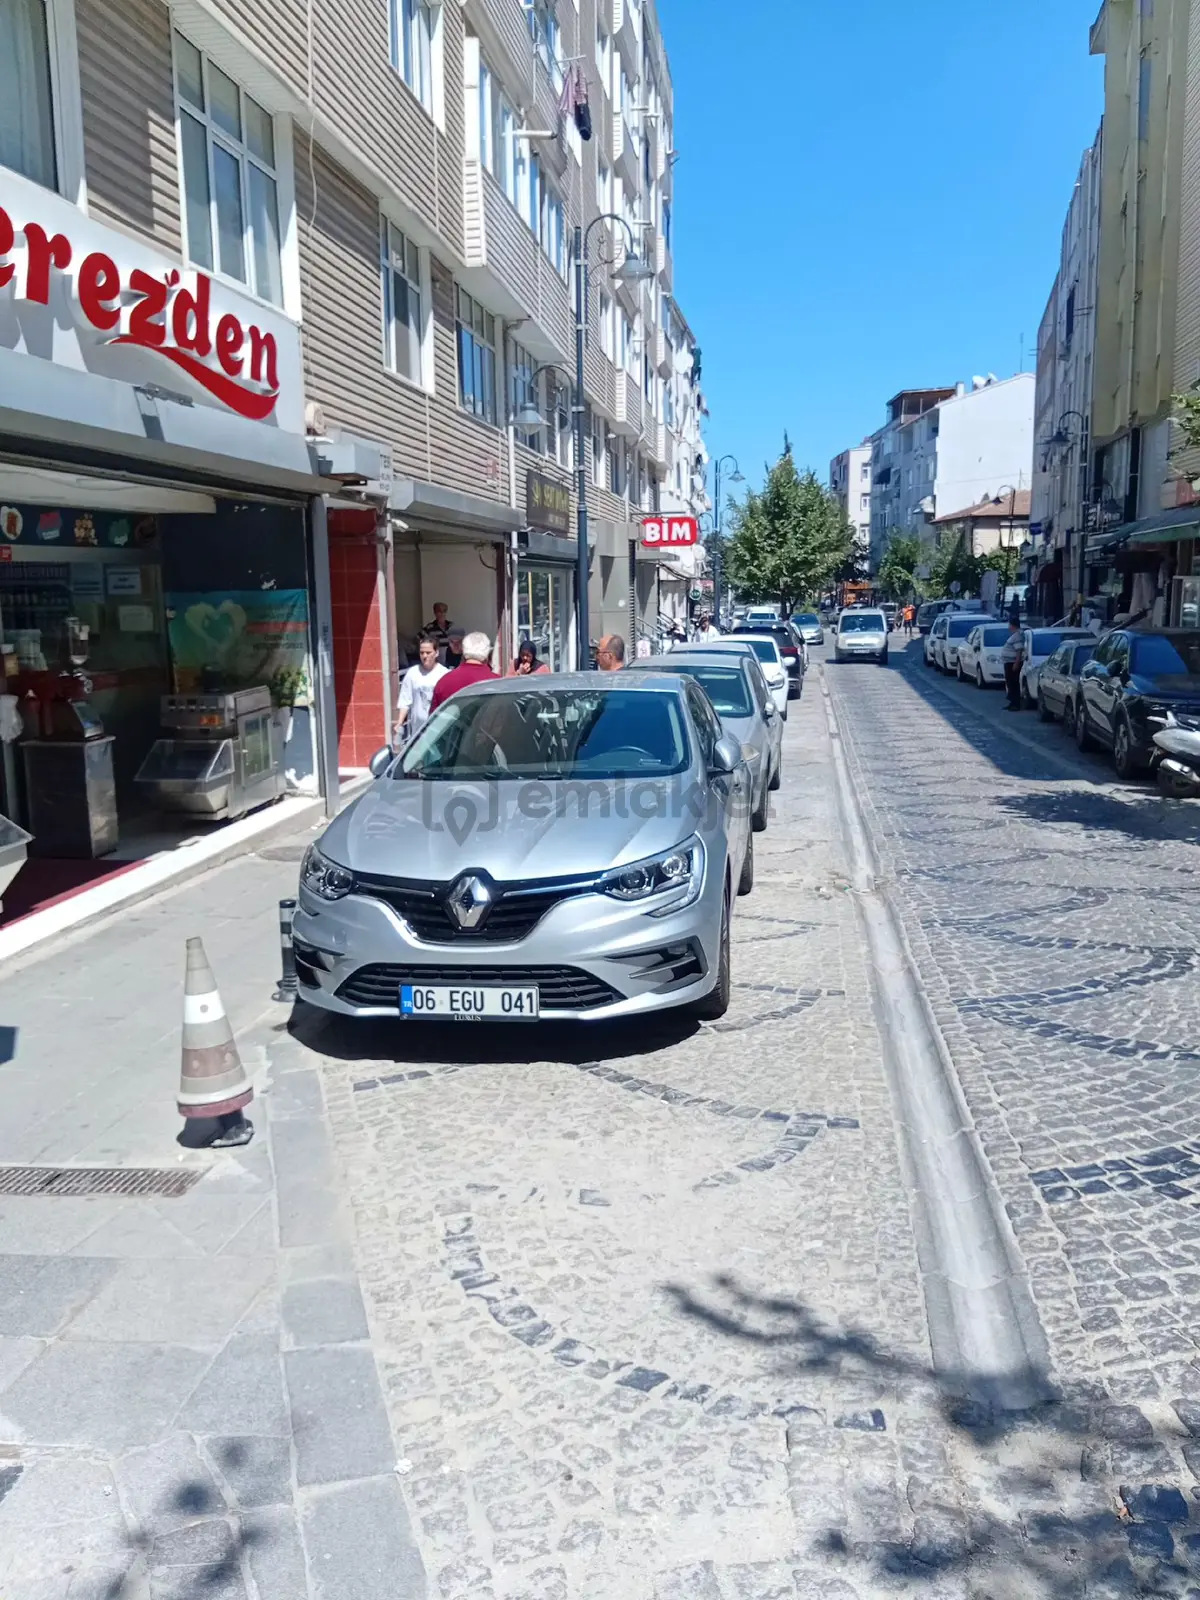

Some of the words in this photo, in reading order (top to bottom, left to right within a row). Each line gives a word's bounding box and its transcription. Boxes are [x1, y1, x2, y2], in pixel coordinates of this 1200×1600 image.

[645, 517, 691, 542] BİM
[413, 989, 436, 1010] 06
[449, 990, 484, 1012] EGU
[501, 991, 533, 1013] 041
